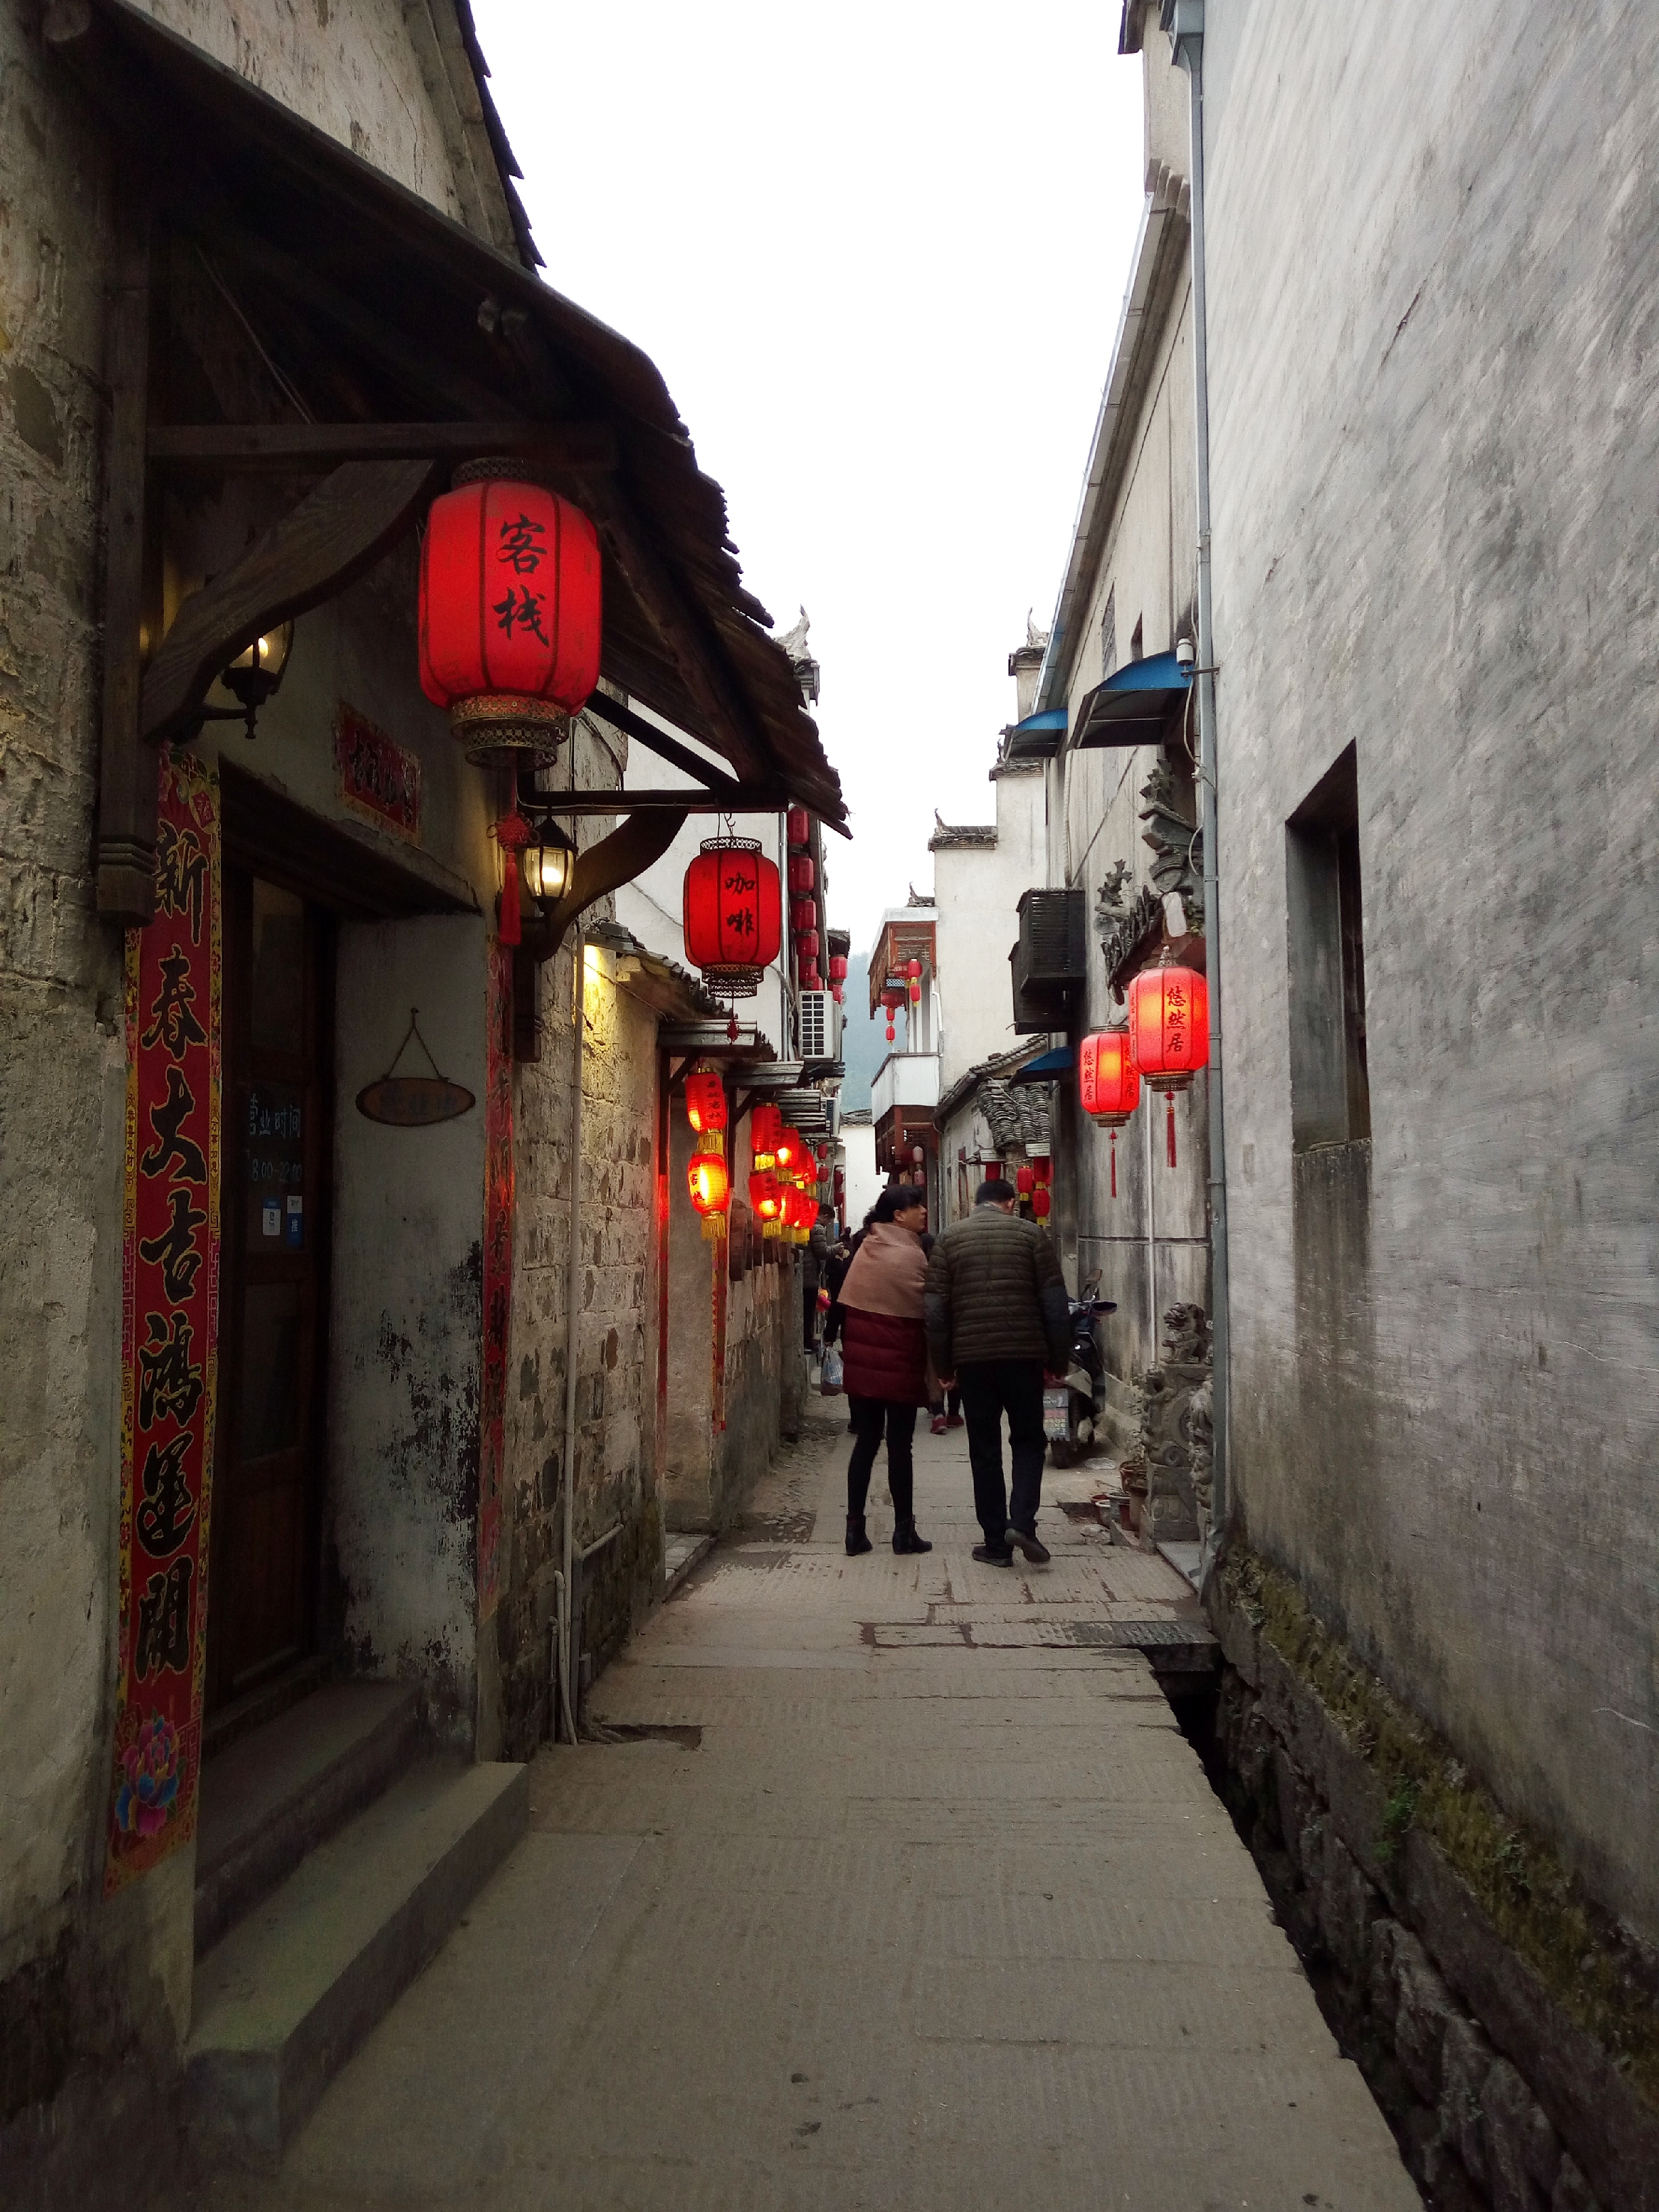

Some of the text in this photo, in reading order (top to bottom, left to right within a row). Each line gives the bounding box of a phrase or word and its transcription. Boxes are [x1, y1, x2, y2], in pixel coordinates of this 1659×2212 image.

[492, 512, 550, 647] 客栈
[724, 871, 757, 937] 咖啡
[1166, 985, 1187, 1053] 悠然居
[1084, 1049, 1094, 1101] 悠然居
[249, 1092, 301, 1139] 营业时间
